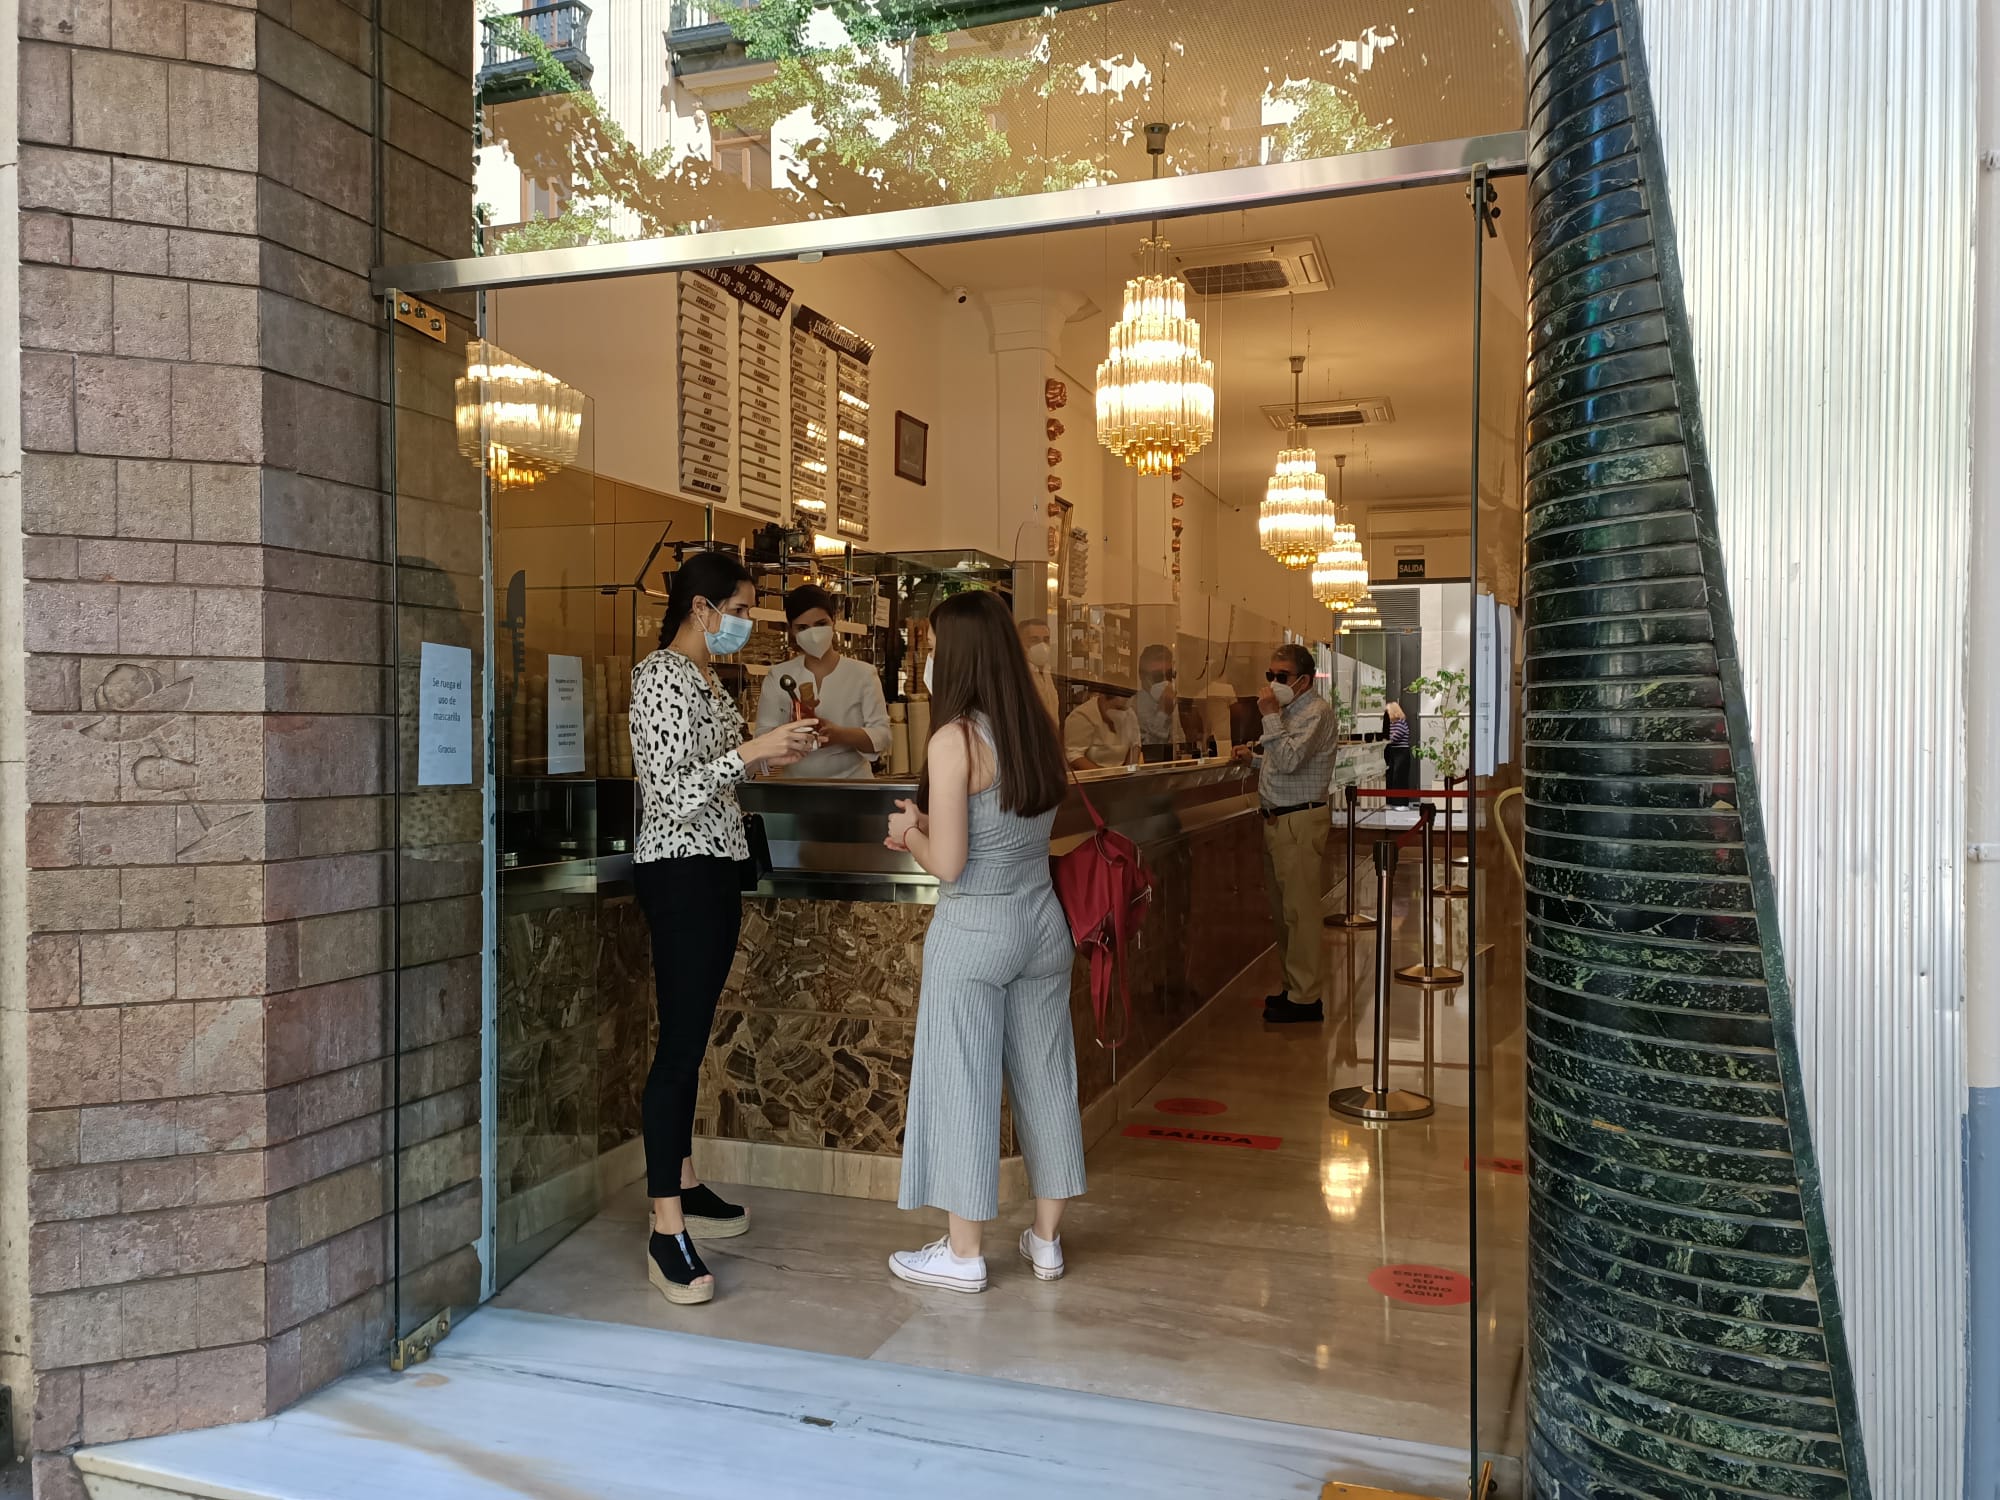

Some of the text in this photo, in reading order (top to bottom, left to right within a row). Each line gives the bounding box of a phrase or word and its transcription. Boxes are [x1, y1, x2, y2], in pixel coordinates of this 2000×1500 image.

[1399, 564, 1424, 573] SALIDA
[432, 677, 462, 691] Se ruega el
[438, 696, 456, 706] uso de
[433, 712, 461, 722] mascarilla
[438, 744, 456, 754] Gracias
[1148, 1129, 1253, 1145] SALIDA
[1393, 1270, 1455, 1281] ESPERE
[1394, 1282, 1453, 1293] TURNO
